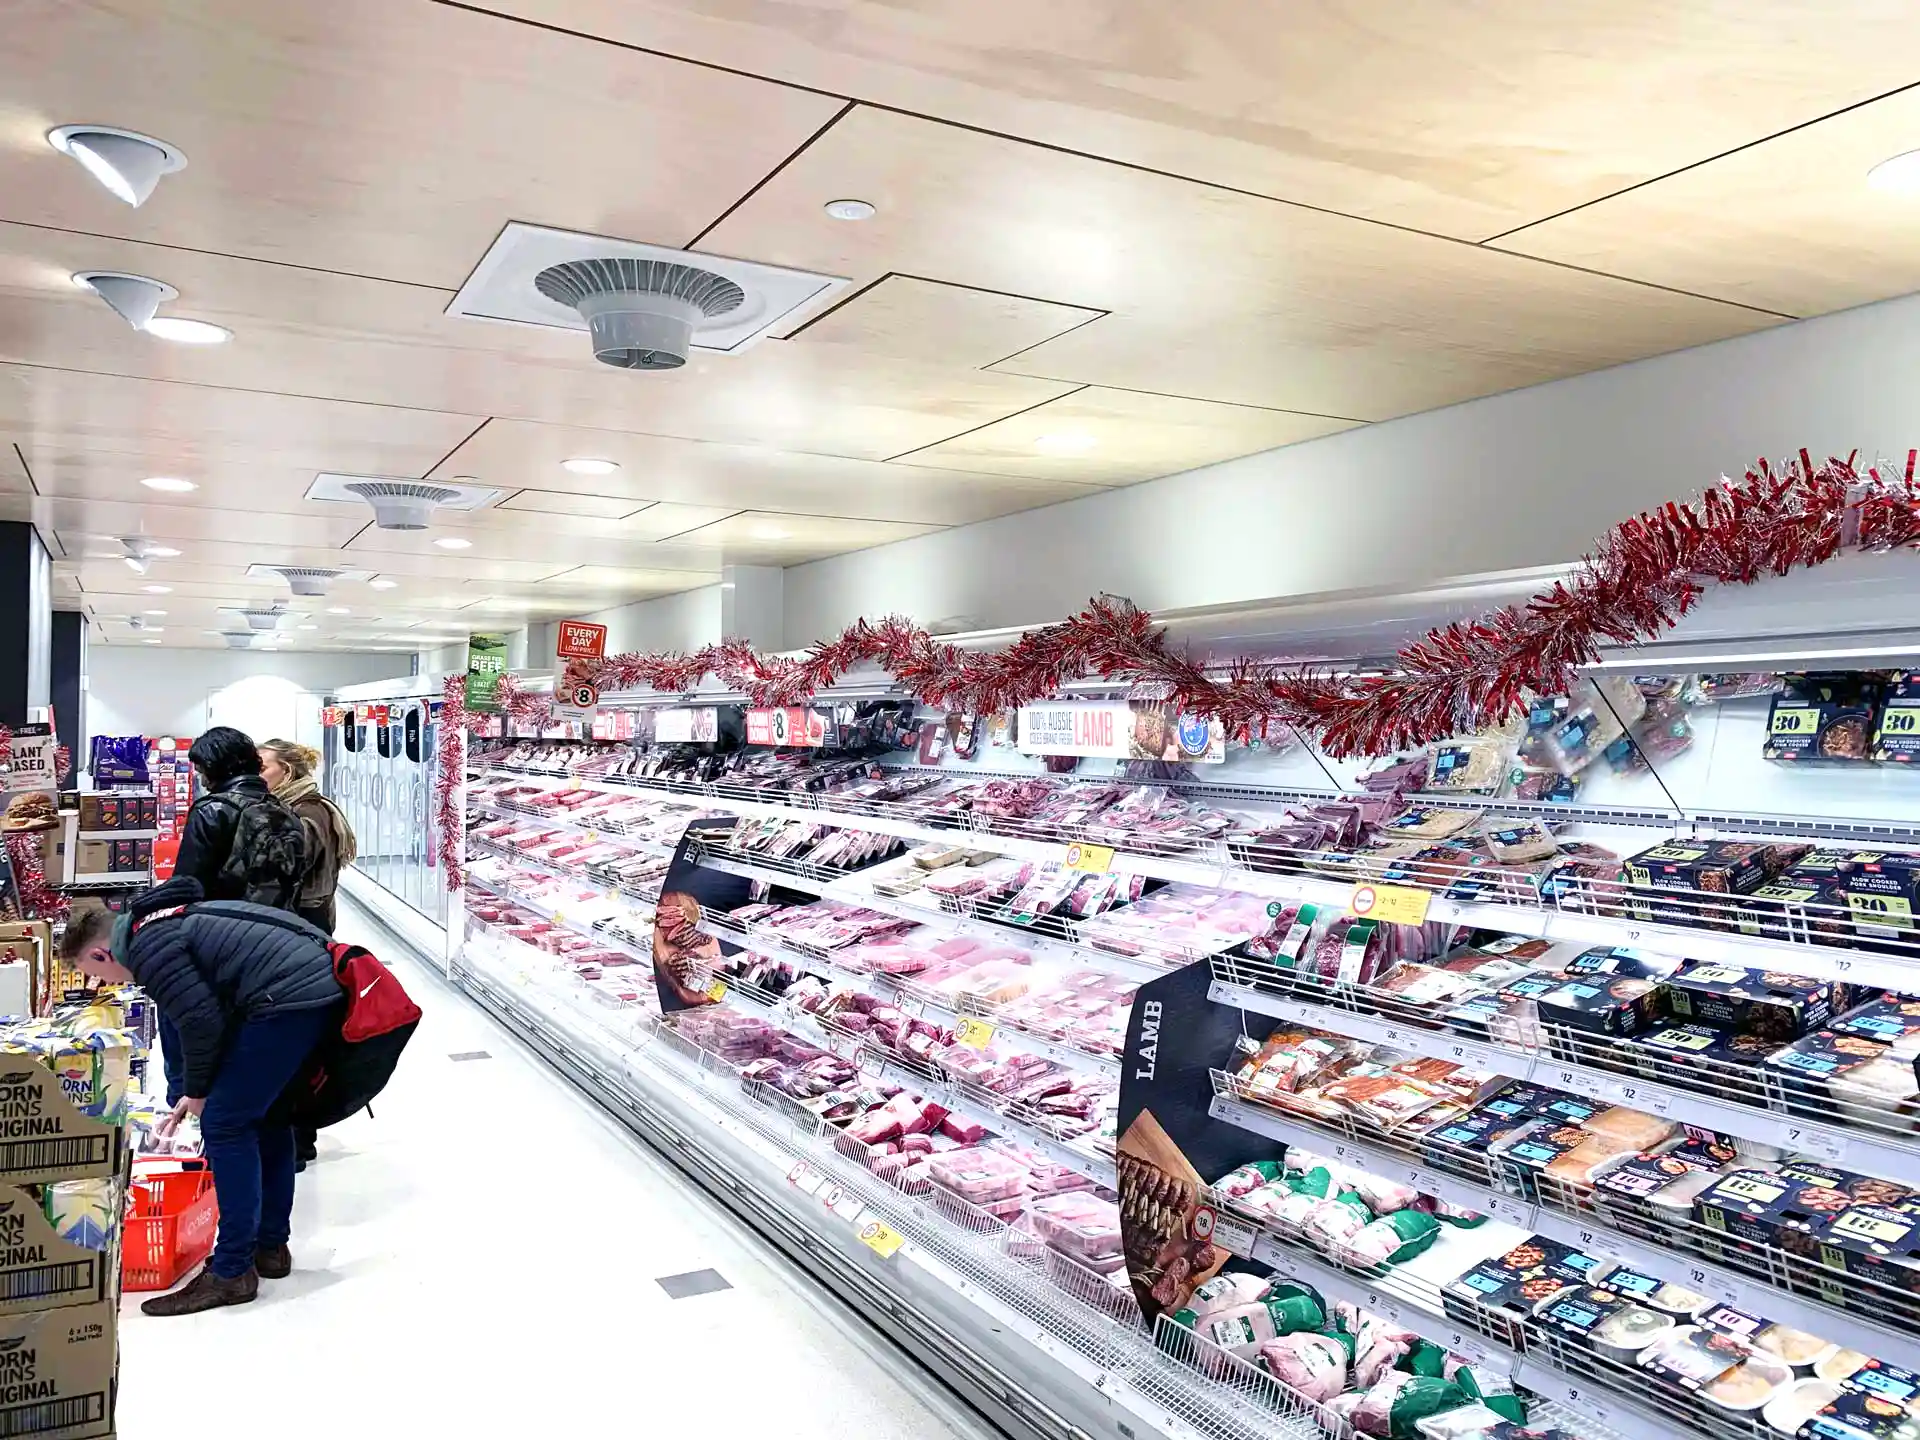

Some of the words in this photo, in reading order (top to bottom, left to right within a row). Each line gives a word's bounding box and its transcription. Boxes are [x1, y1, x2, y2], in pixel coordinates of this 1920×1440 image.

[567, 627, 599, 639] EVERY
[571, 637, 592, 647] DAY
[471, 660, 504, 673] BEEF
[575, 689, 590, 702] $8
[1029, 711, 1047, 730] 100%
[1048, 711, 1073, 731] AUSSIE
[1074, 711, 1114, 747] LAMB
[12, 747, 43, 759] LANT
[684, 840, 699, 864] BE
[1632, 867, 1648, 879] 30
[1136, 1000, 1162, 1081] LAMB
[1561, 1072, 1573, 1083] $12
[0, 1085, 43, 1101] ORN
[68, 1092, 92, 1104] INS
[1622, 1086, 1636, 1099] $12
[0, 1100, 41, 1118] HINS
[0, 1117, 64, 1138] IGINAL
[1789, 1128, 1800, 1140] $7
[1488, 1198, 1497, 1209] $6
[1217, 1215, 1233, 1229] DOWN
[1580, 1230, 1592, 1244] $12
[1690, 1267, 1704, 1284] $12
[1369, 1294, 1377, 1304] $9
[1555, 1303, 1577, 1318] 25
[1452, 1334, 1461, 1345] $9
[0, 1379, 59, 1405] IGINAL
[1568, 1388, 1578, 1399] $9
